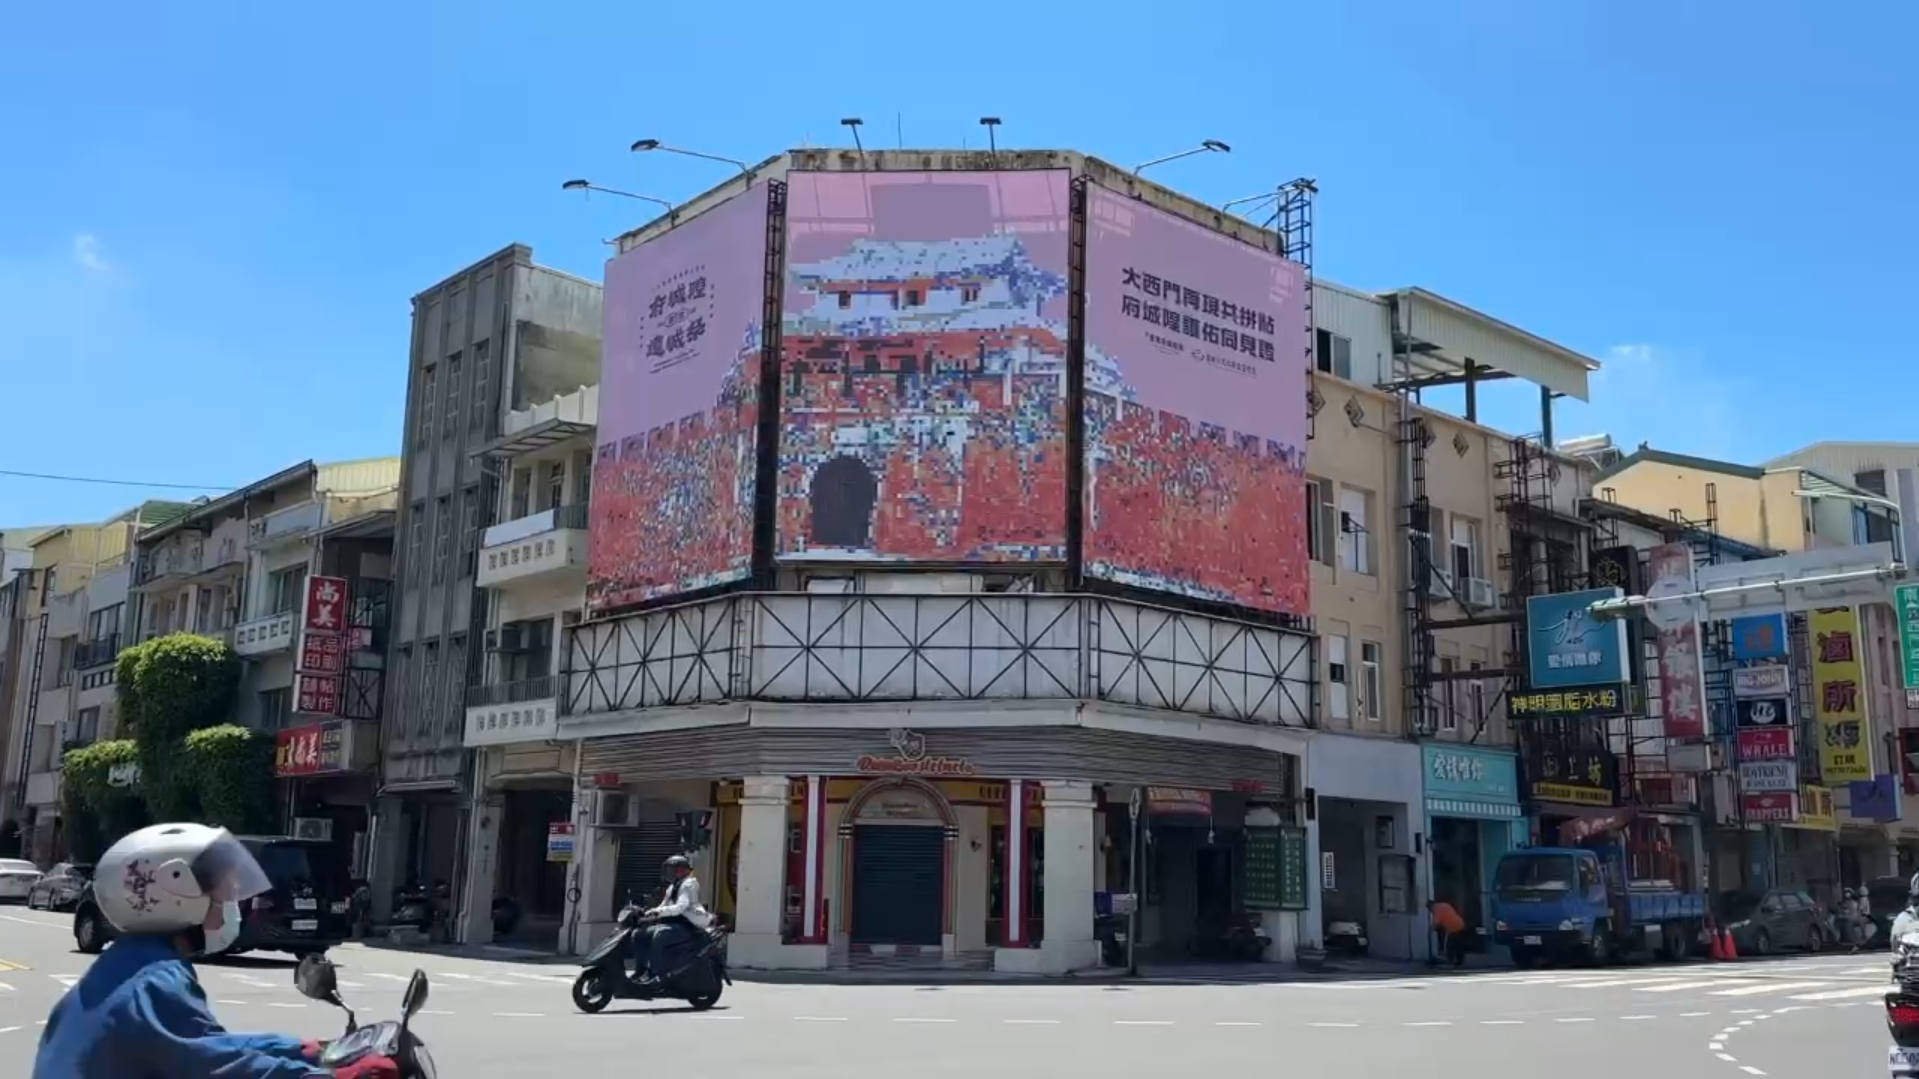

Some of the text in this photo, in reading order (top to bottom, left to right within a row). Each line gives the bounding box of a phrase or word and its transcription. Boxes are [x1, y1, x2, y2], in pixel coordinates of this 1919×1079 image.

[1121, 294, 1276, 363] 府城隍護佑同見證
[313, 582, 340, 629] 尚美
[1742, 743, 1787, 757] WHALE
